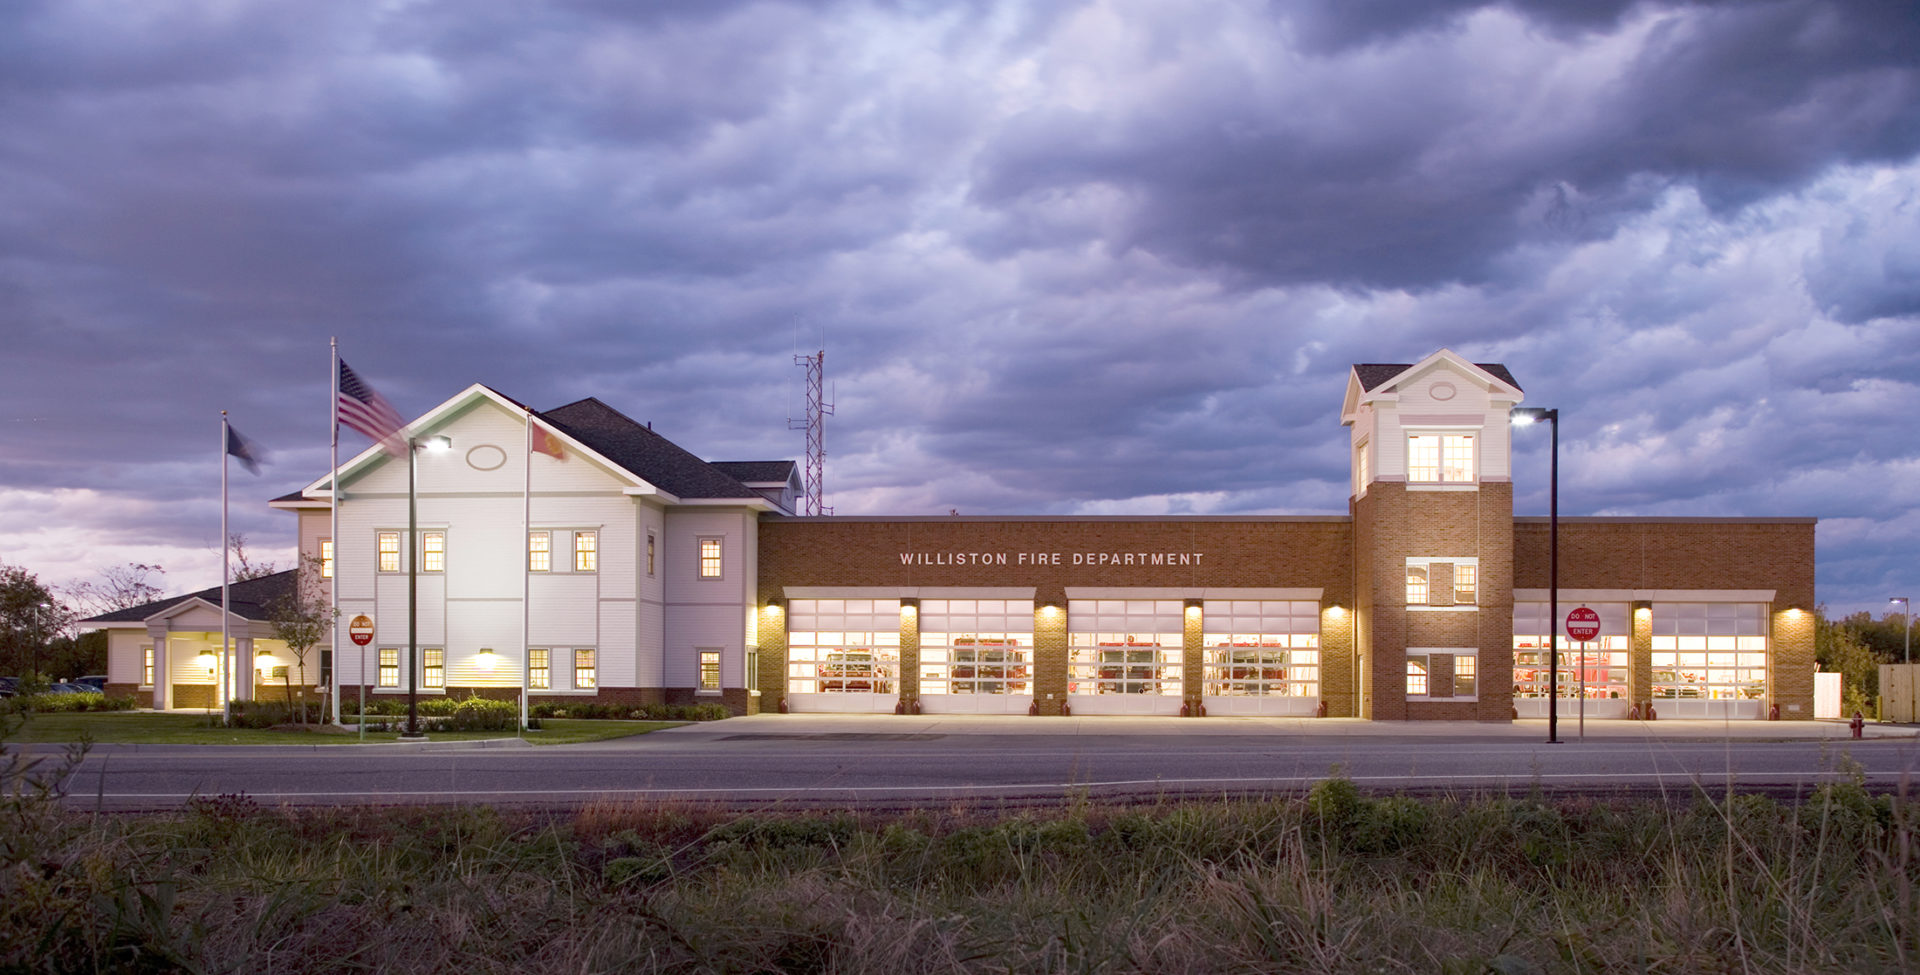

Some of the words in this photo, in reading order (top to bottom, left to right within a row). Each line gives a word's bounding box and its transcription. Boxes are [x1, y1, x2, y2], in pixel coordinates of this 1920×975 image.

[900, 552, 1007, 566] WILLISTON
[1018, 552, 1061, 566] FIRE
[1072, 552, 1204, 566] DEPARTMENT
